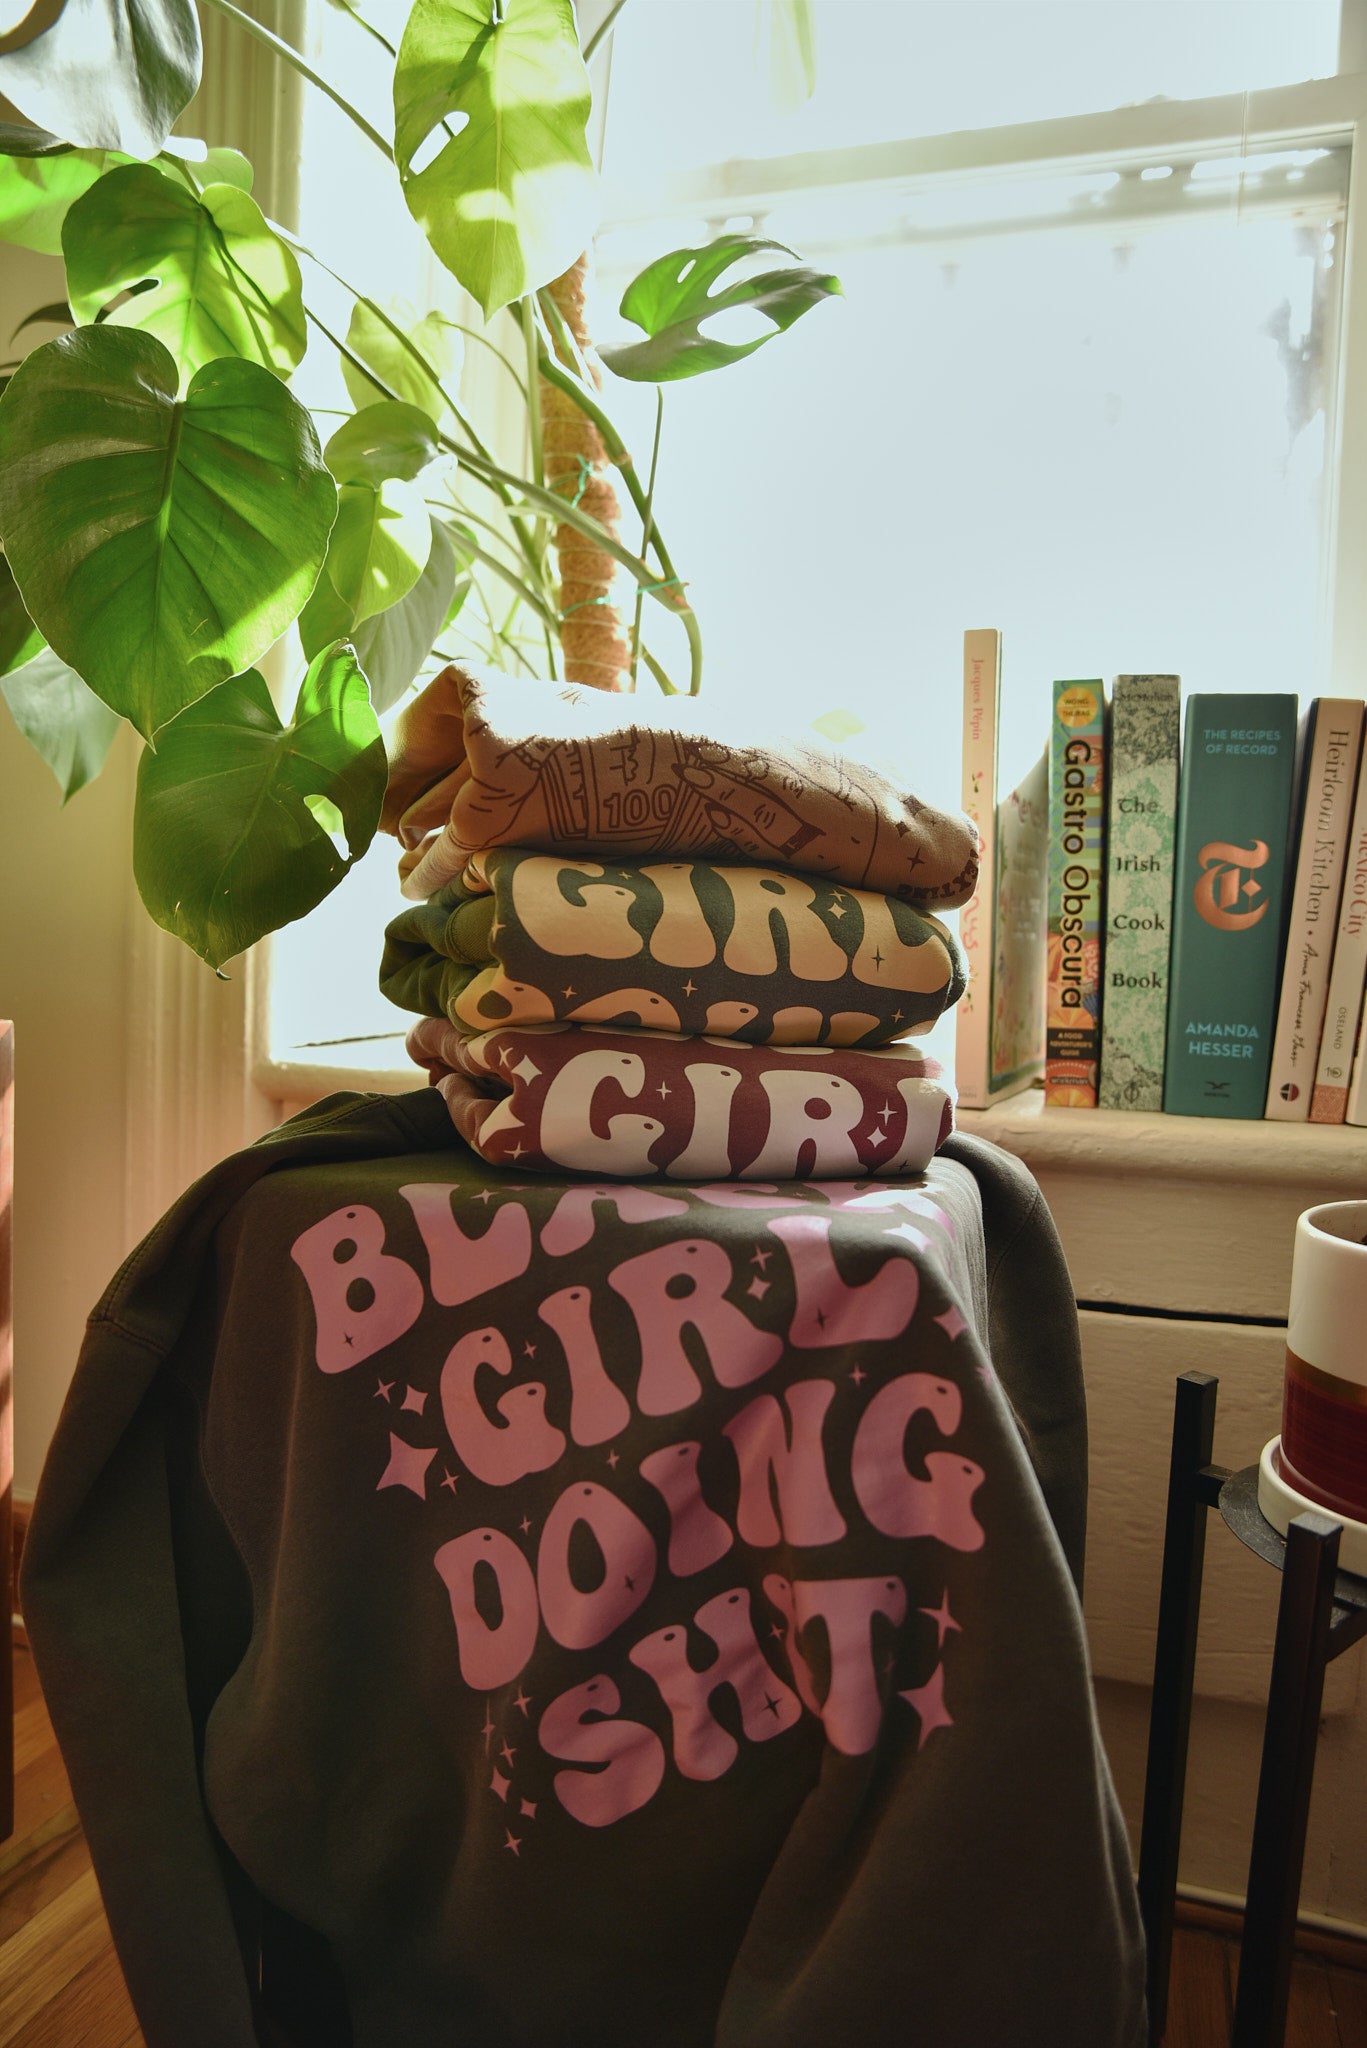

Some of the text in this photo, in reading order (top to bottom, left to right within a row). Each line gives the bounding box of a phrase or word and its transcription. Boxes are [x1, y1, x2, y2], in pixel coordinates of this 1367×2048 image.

[970, 657, 984, 741] Jacques Pépin
[1203, 729, 1282, 741] THE RECIPES
[1205, 744, 1278, 756] OF RECORD
[603, 783, 678, 829] 100
[1117, 796, 1159, 814] The
[1305, 730, 1350, 923] Heirloom Kitchen
[1060, 738, 1092, 1010] Gastro Obscura
[1116, 855, 1161, 872] Irish
[512, 855, 954, 994] GIRL
[1113, 913, 1165, 931] Cook
[1112, 971, 1163, 989] Book
[1185, 1021, 1260, 1039] AMANDA
[1333, 1006, 1347, 1050] OSELAND
[1188, 1041, 1254, 1059] HESSER
[440, 1215, 920, 1487] GIRL
[434, 1372, 986, 1692] DOING
